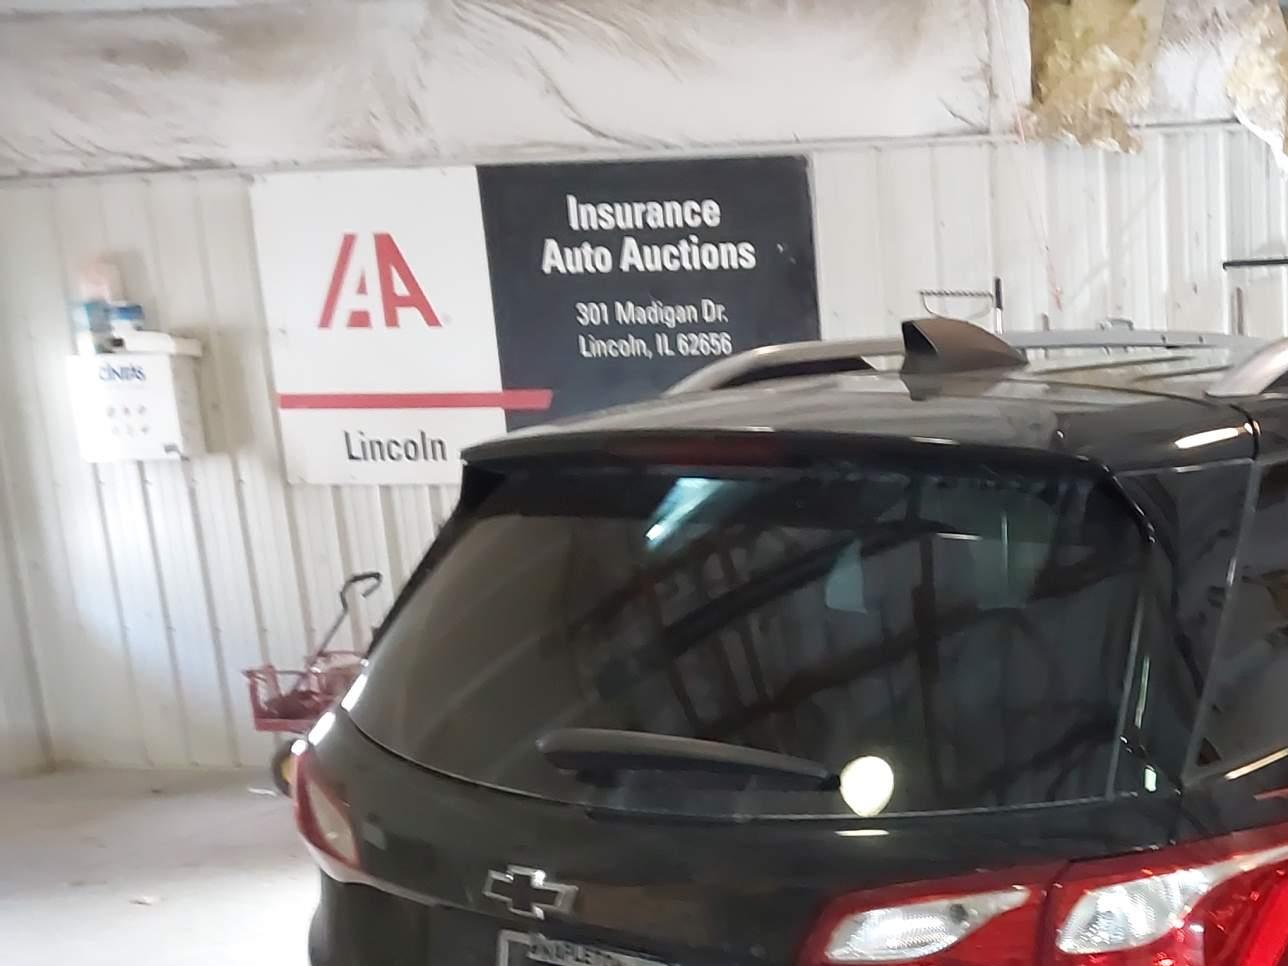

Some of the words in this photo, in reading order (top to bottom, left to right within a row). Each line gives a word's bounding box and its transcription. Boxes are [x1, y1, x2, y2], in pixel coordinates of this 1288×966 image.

[566, 194, 721, 231] Insurance
[541, 238, 613, 274] Auto
[619, 235, 757, 272] Auctions
[575, 302, 609, 326] 301
[614, 300, 699, 328] Madigan
[701, 298, 729, 323] Dr.
[578, 334, 653, 358] Lincoln,
[655, 333, 676, 356] IL
[676, 332, 733, 356] 62656
[344, 429, 448, 463] Lincoln
